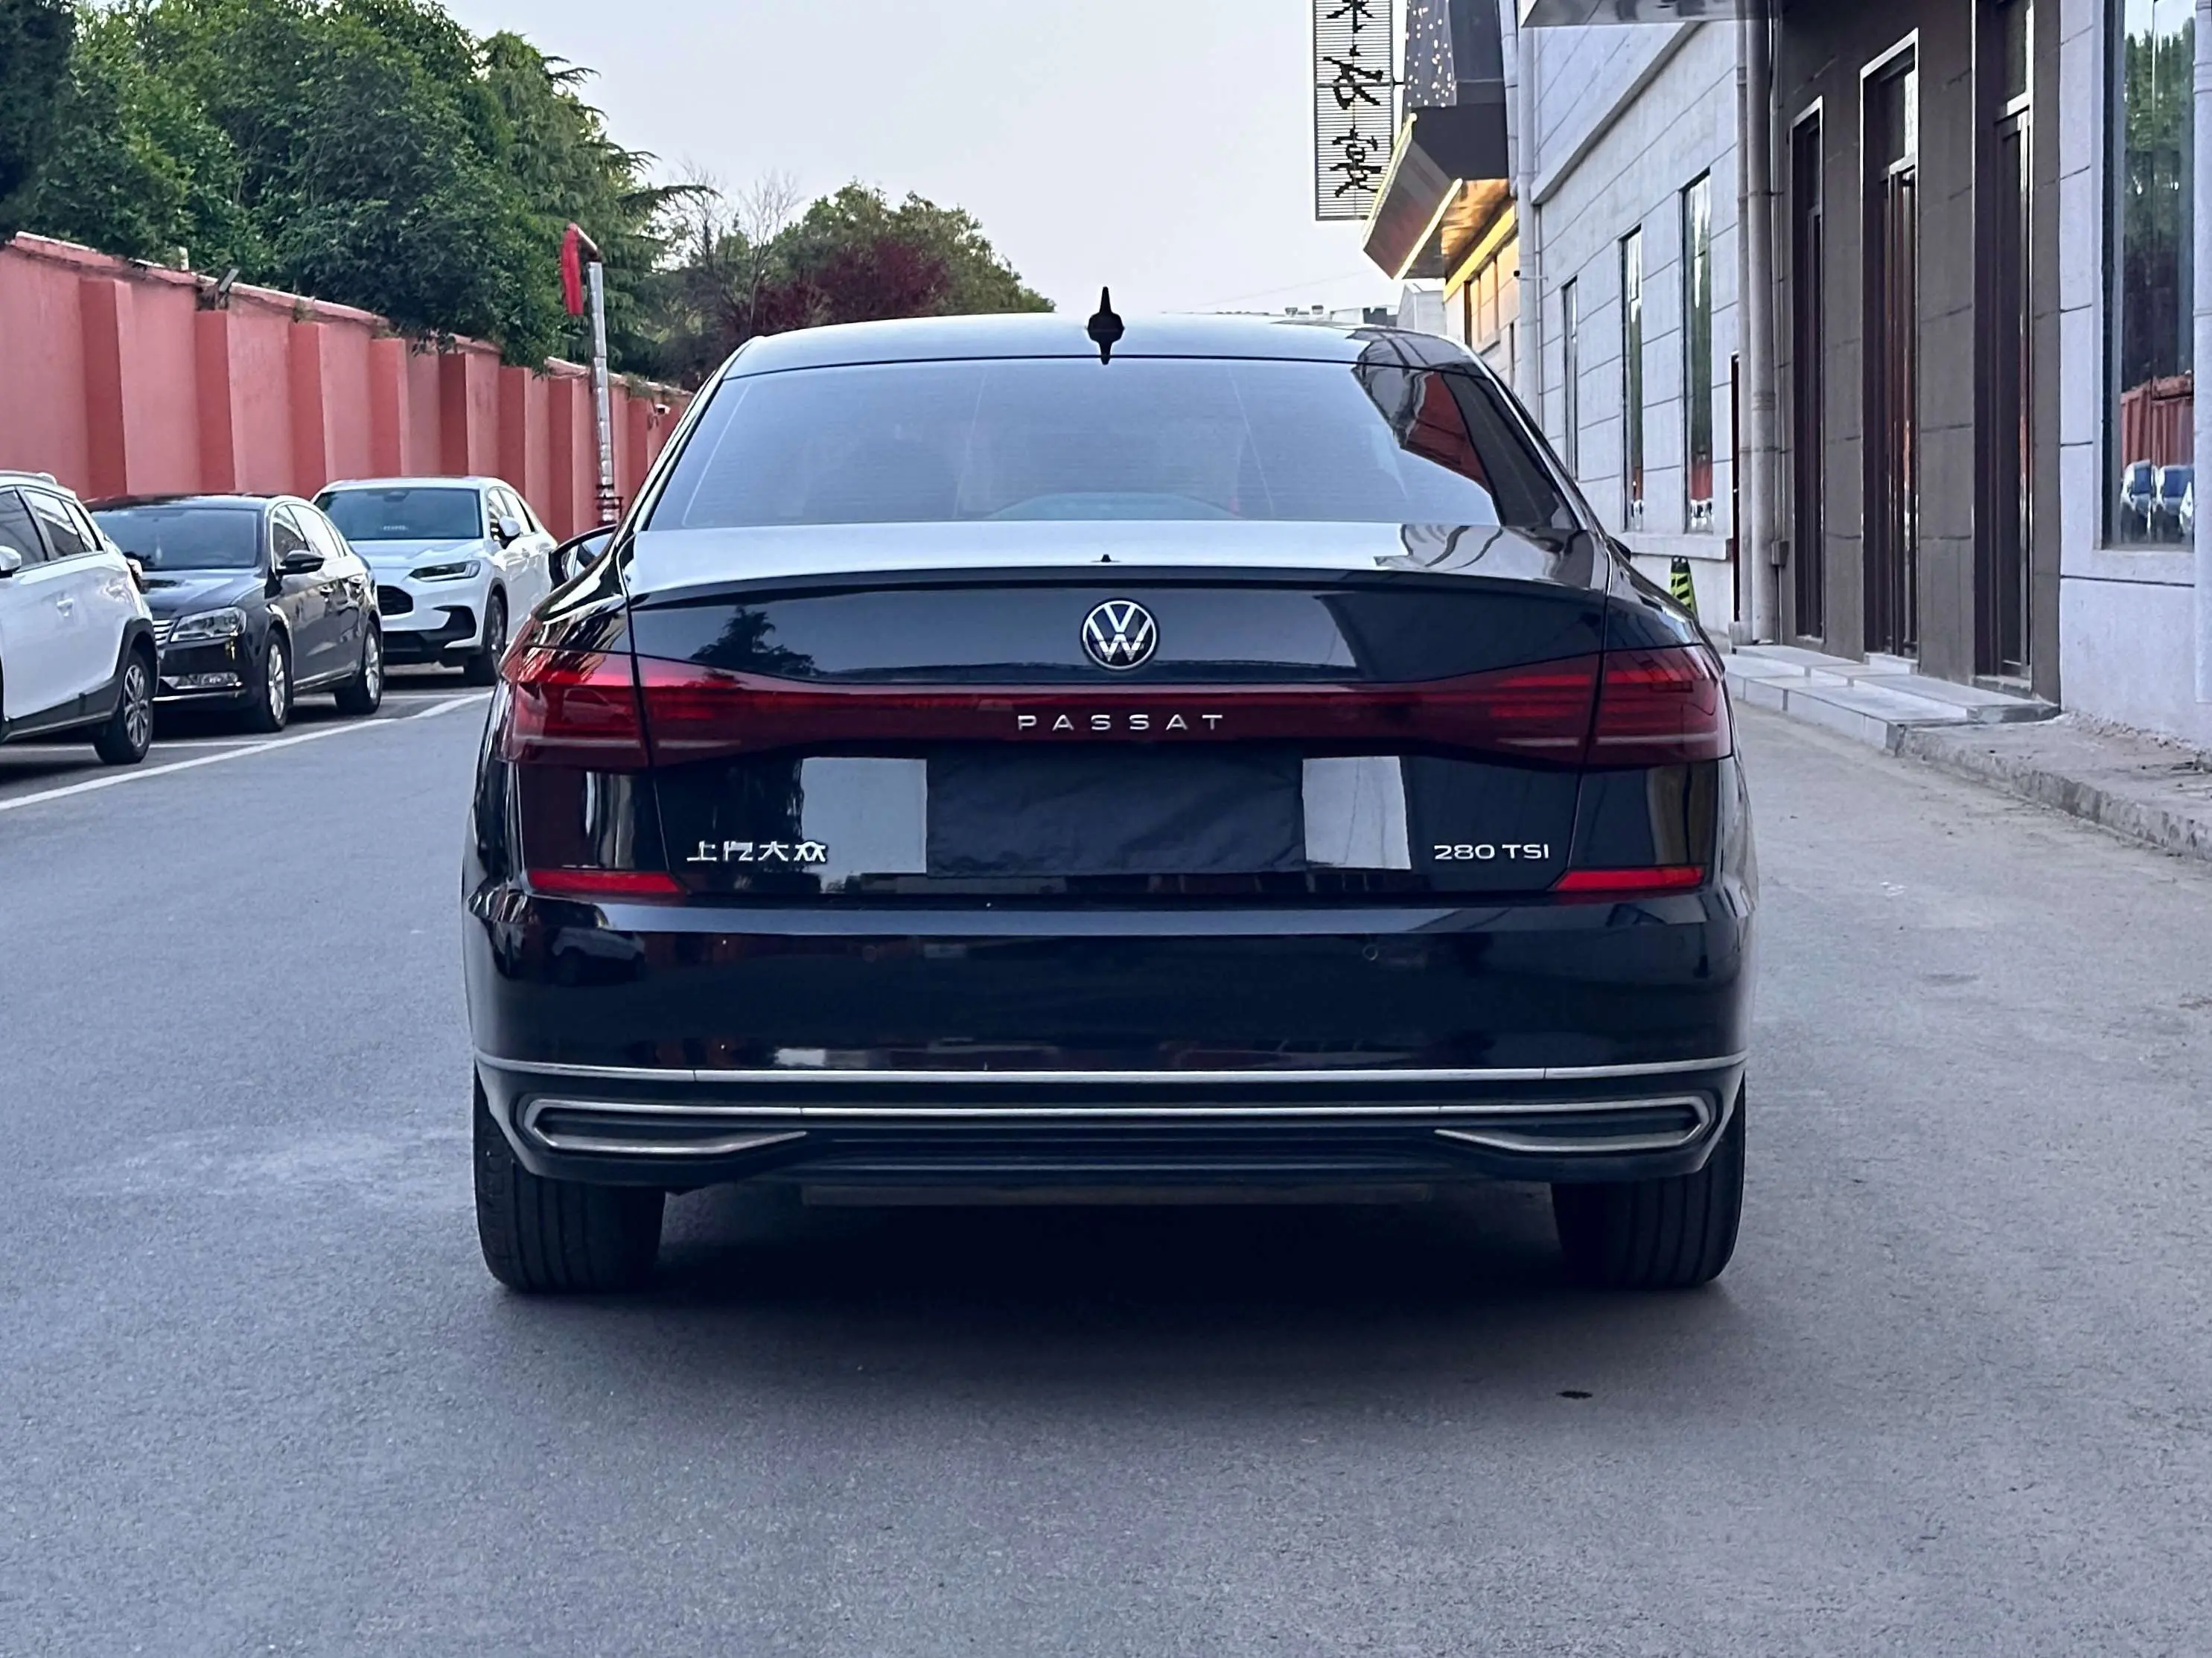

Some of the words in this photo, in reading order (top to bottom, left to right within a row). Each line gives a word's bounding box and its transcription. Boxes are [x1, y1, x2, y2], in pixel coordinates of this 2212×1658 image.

[1017, 714, 1223, 731] PASSAT
[686, 841, 826, 862] 上汽大众
[1434, 844, 1496, 860] 280
[1502, 844, 1549, 859] TSI
